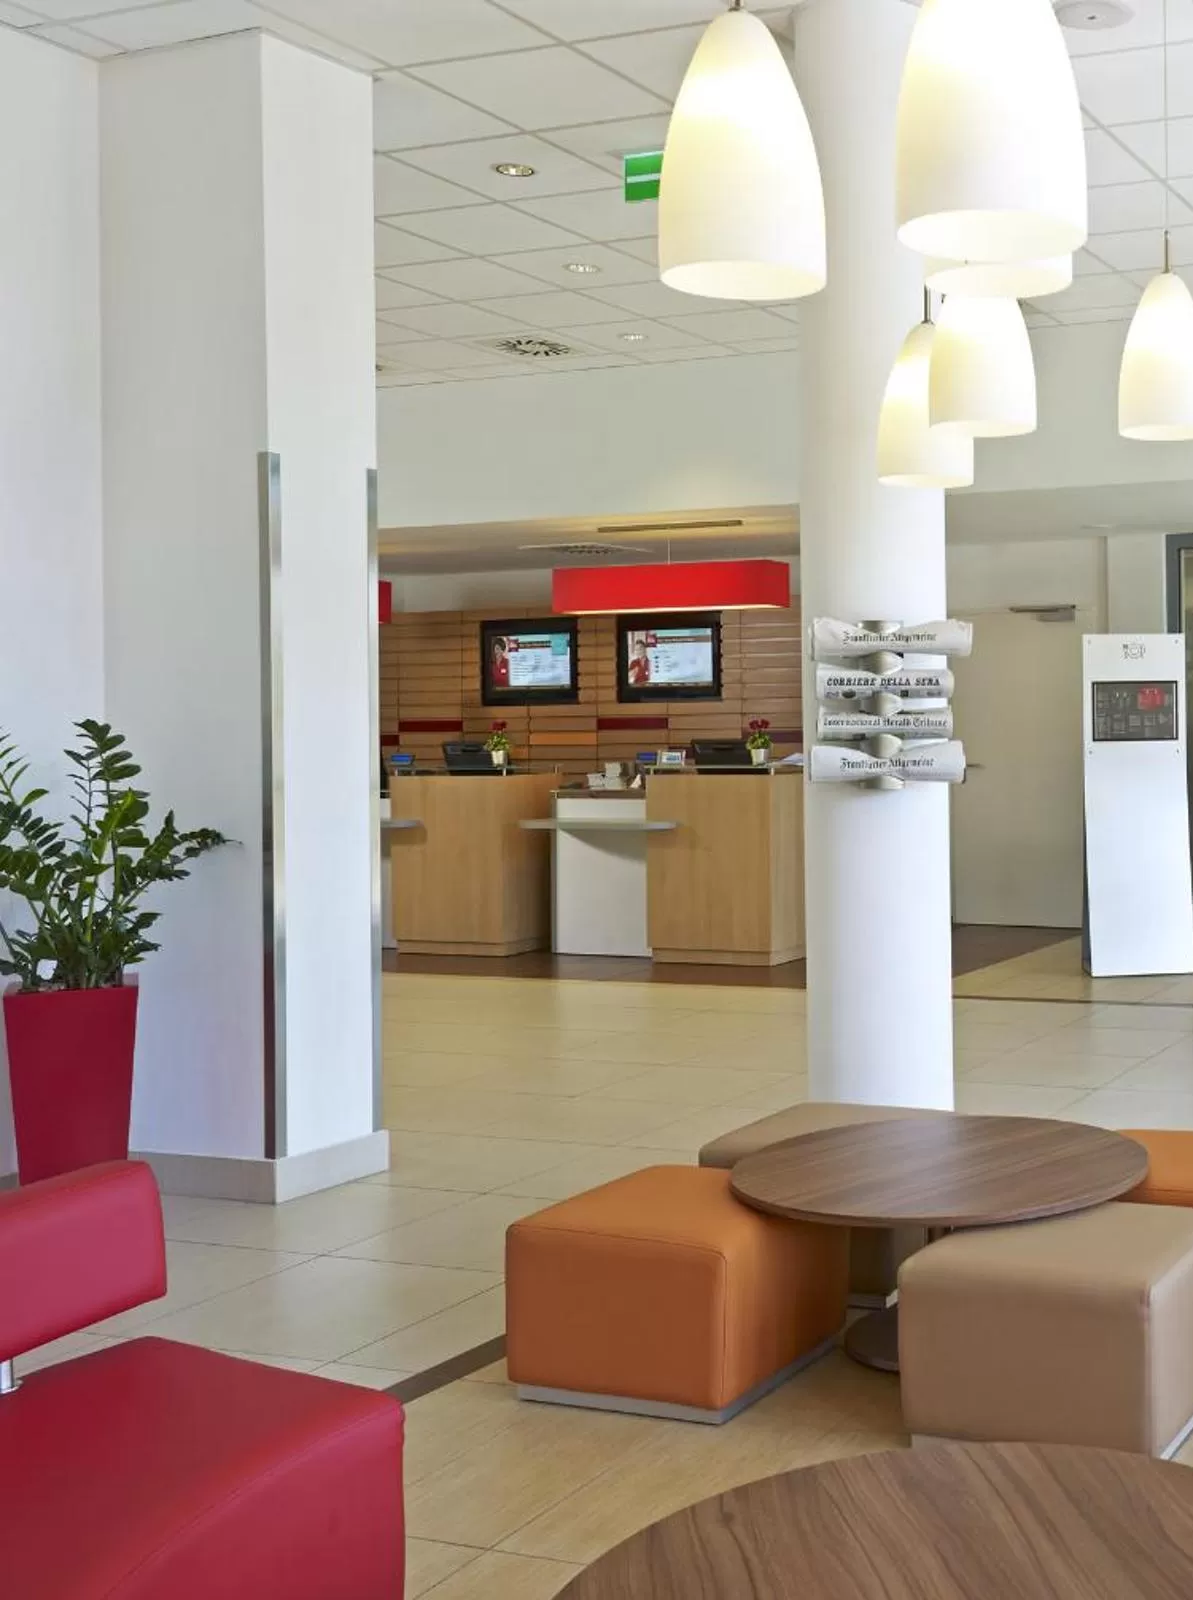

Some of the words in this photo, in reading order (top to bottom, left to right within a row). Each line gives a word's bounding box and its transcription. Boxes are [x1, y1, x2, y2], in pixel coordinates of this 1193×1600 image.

[826, 678, 876, 687] CORRIERE
[880, 678, 911, 687] DELLA
[915, 678, 940, 687] SERA
